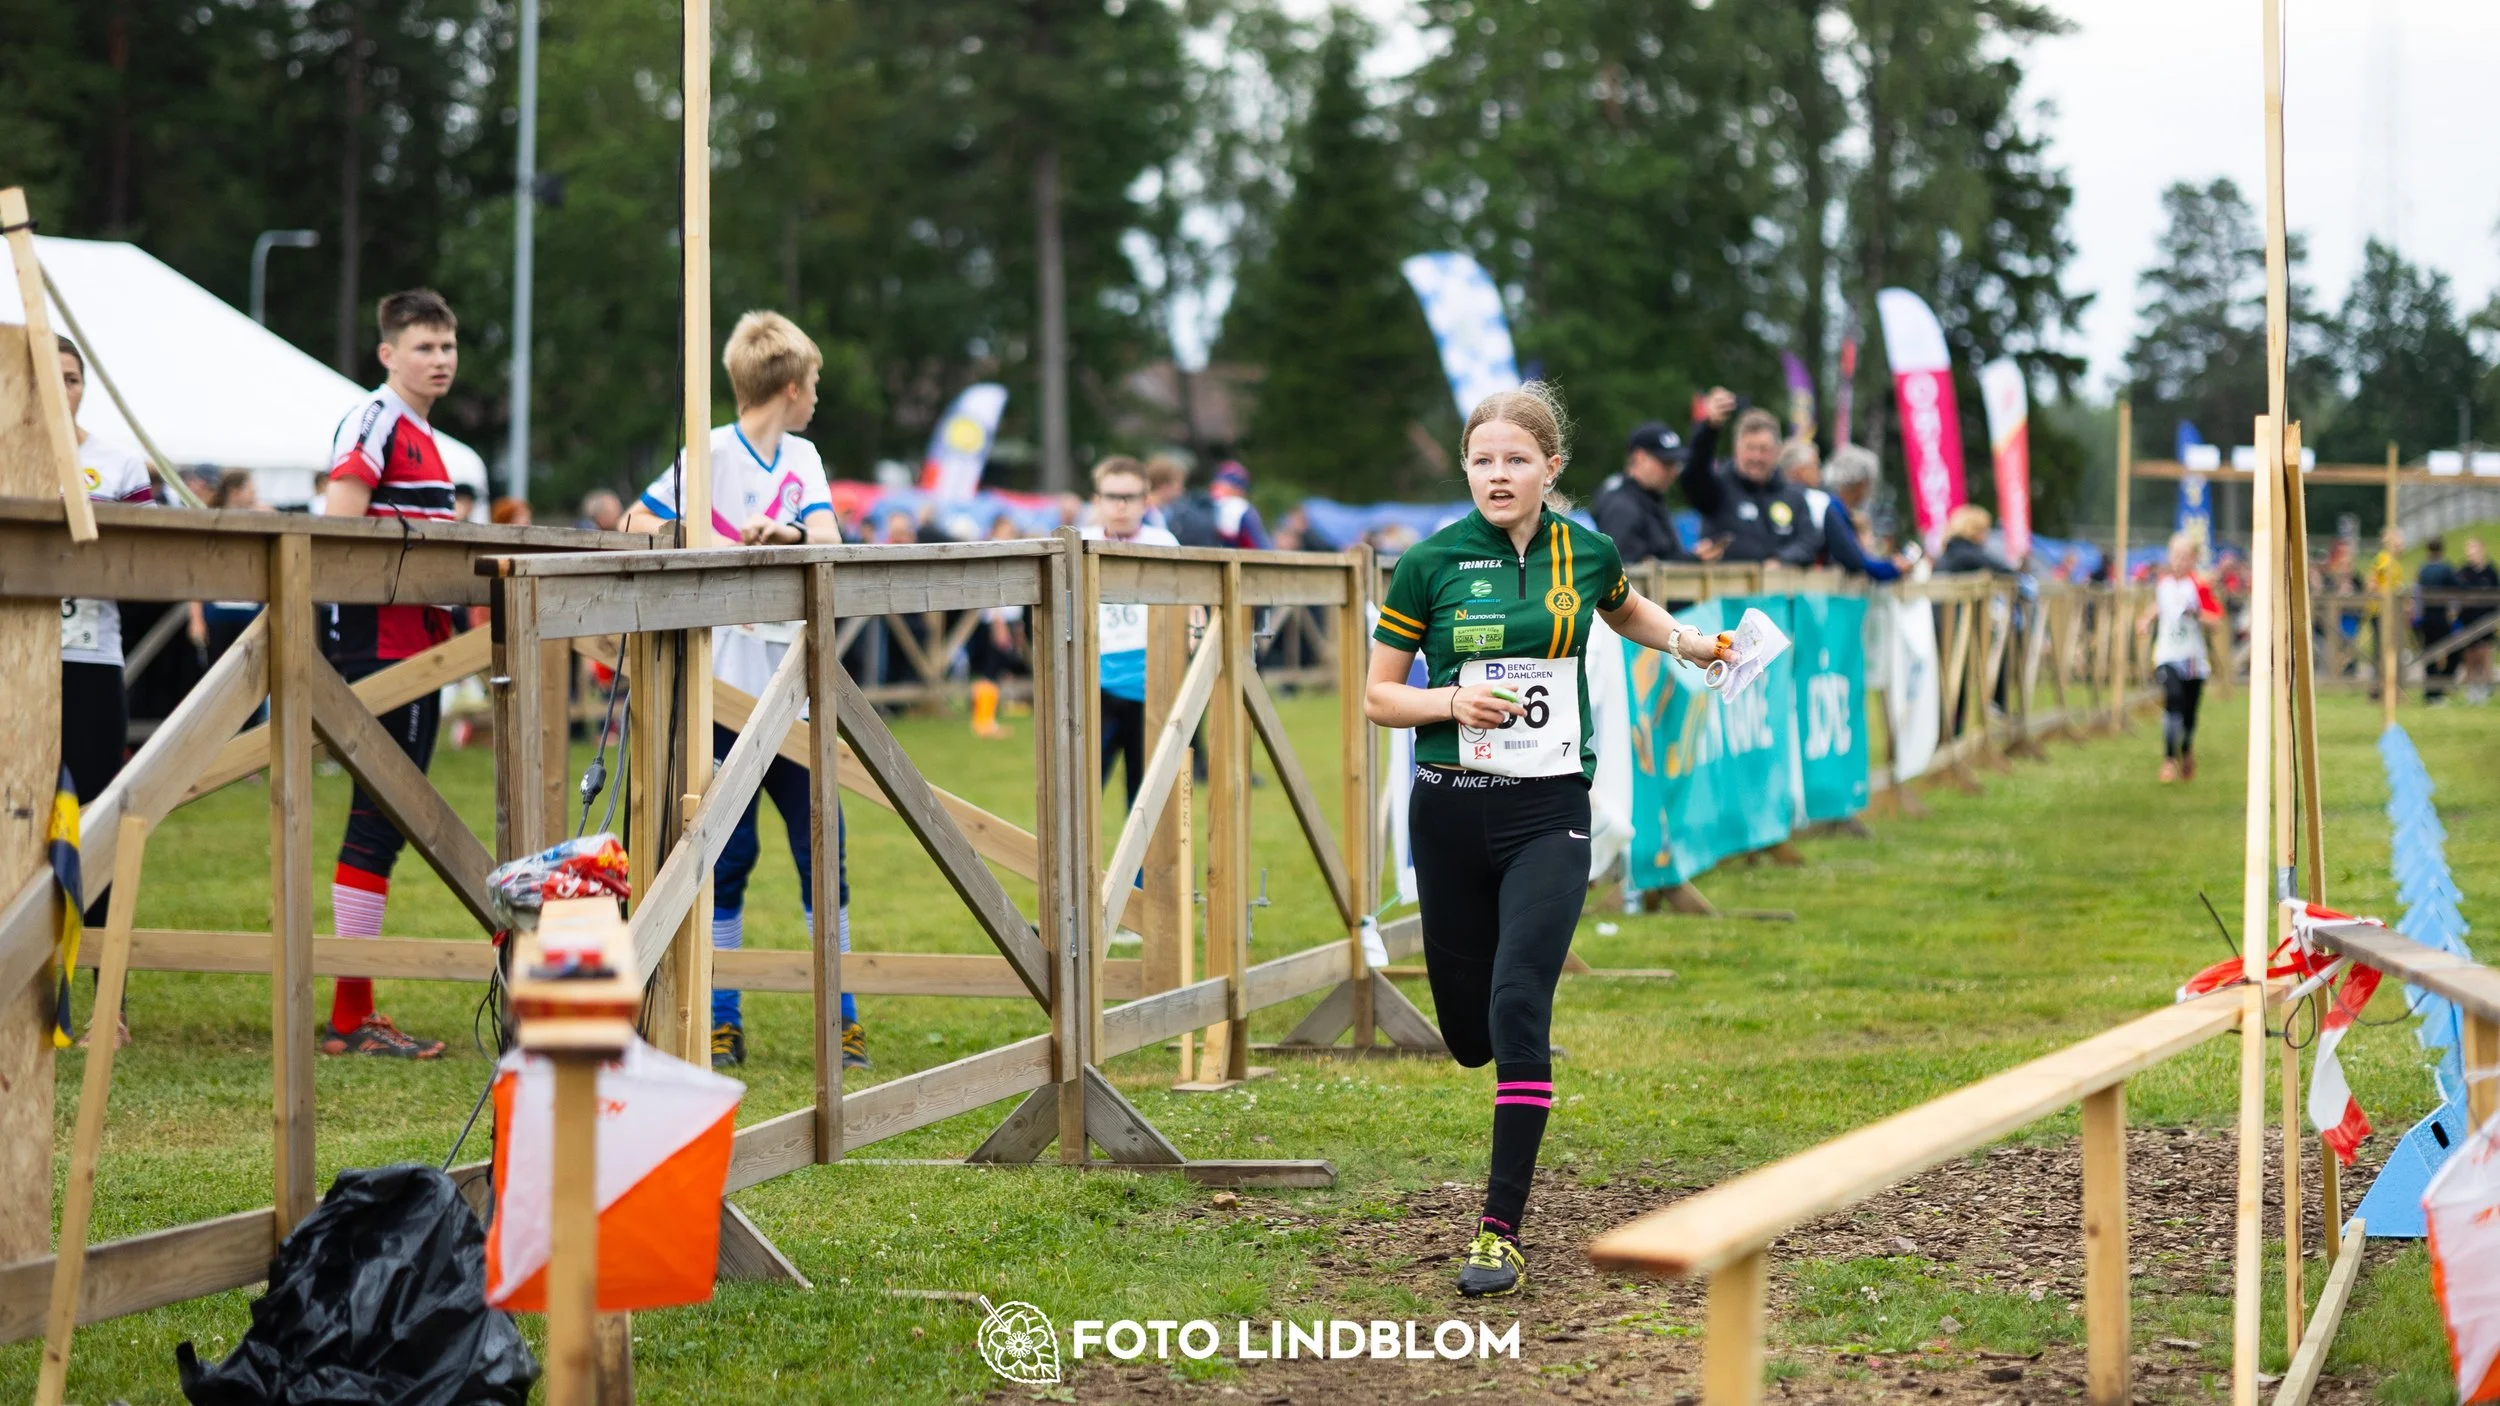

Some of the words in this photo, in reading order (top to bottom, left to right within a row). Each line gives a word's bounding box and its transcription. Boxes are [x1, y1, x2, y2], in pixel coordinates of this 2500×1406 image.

[1458, 559, 1503, 571] TRIMTEX
[1507, 663, 1536, 671] BENGT
[1507, 671, 1553, 679] DAHLGREN
[1561, 742, 1571, 757] 7
[1416, 767, 1443, 784] PRO
[1452, 775, 1489, 788] NIKE
